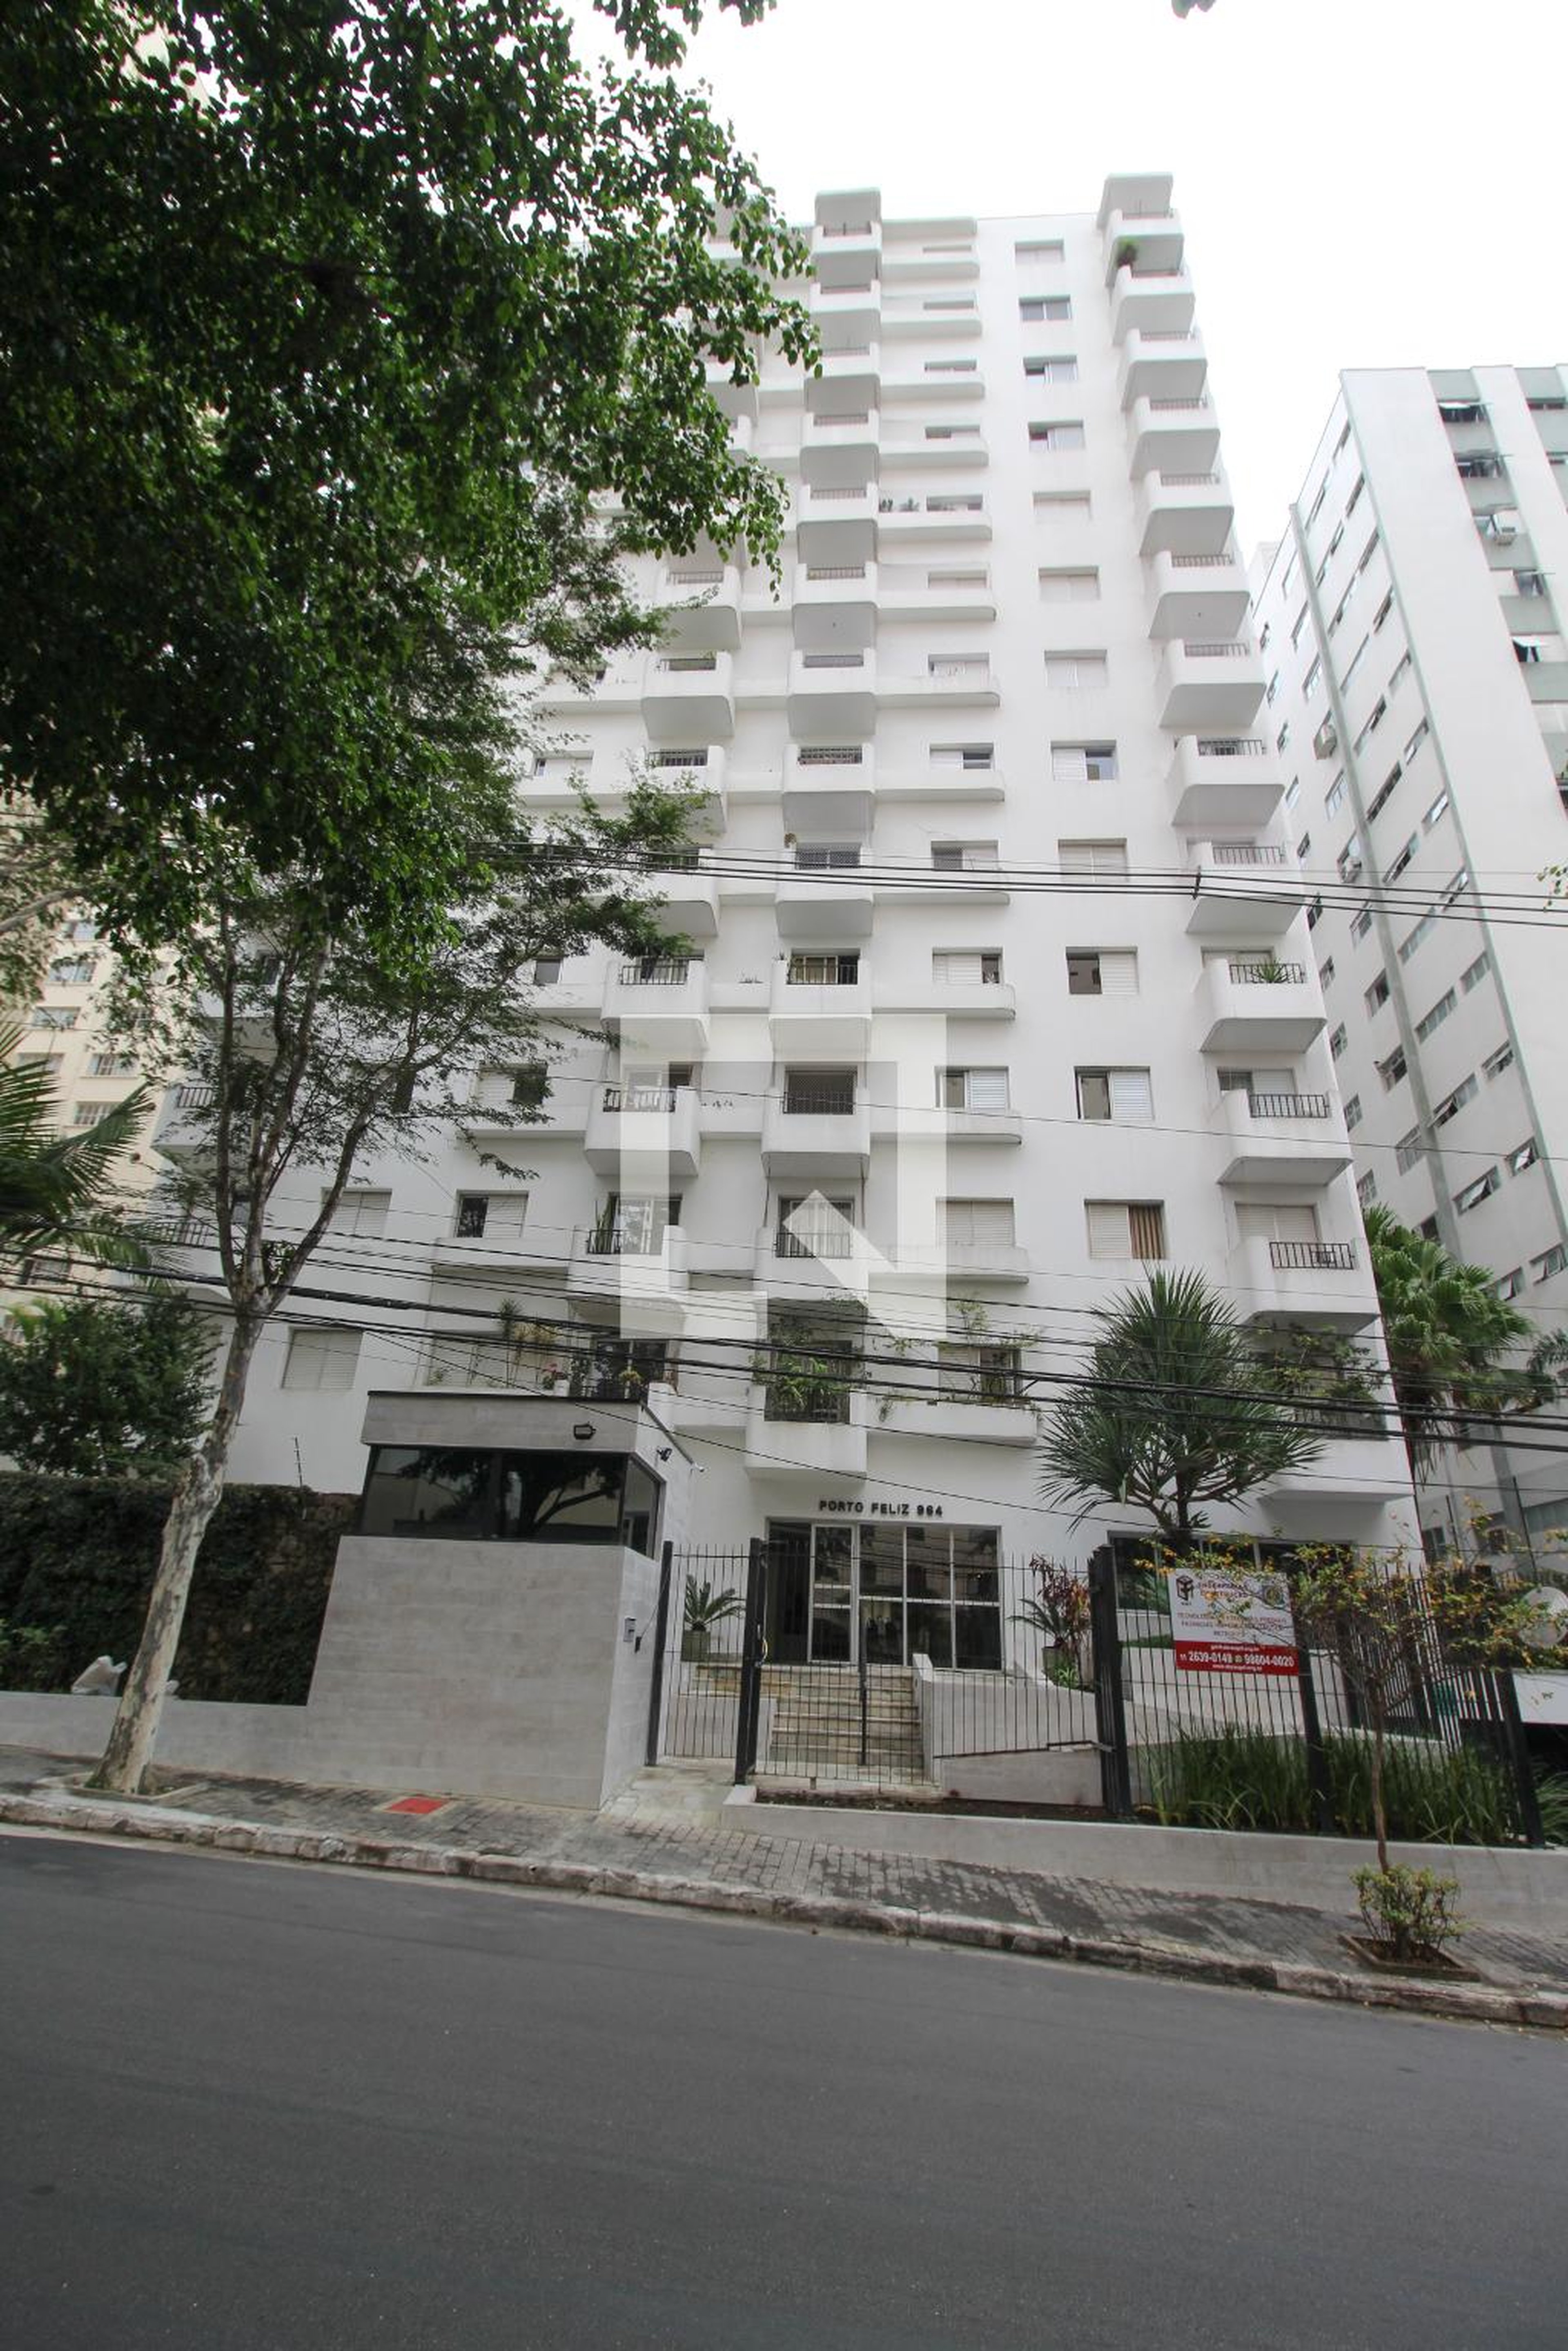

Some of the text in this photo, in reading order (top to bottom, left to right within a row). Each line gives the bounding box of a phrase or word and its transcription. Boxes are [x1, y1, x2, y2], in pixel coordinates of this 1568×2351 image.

[819, 1500, 943, 1517] PORTO FELIZ 964
